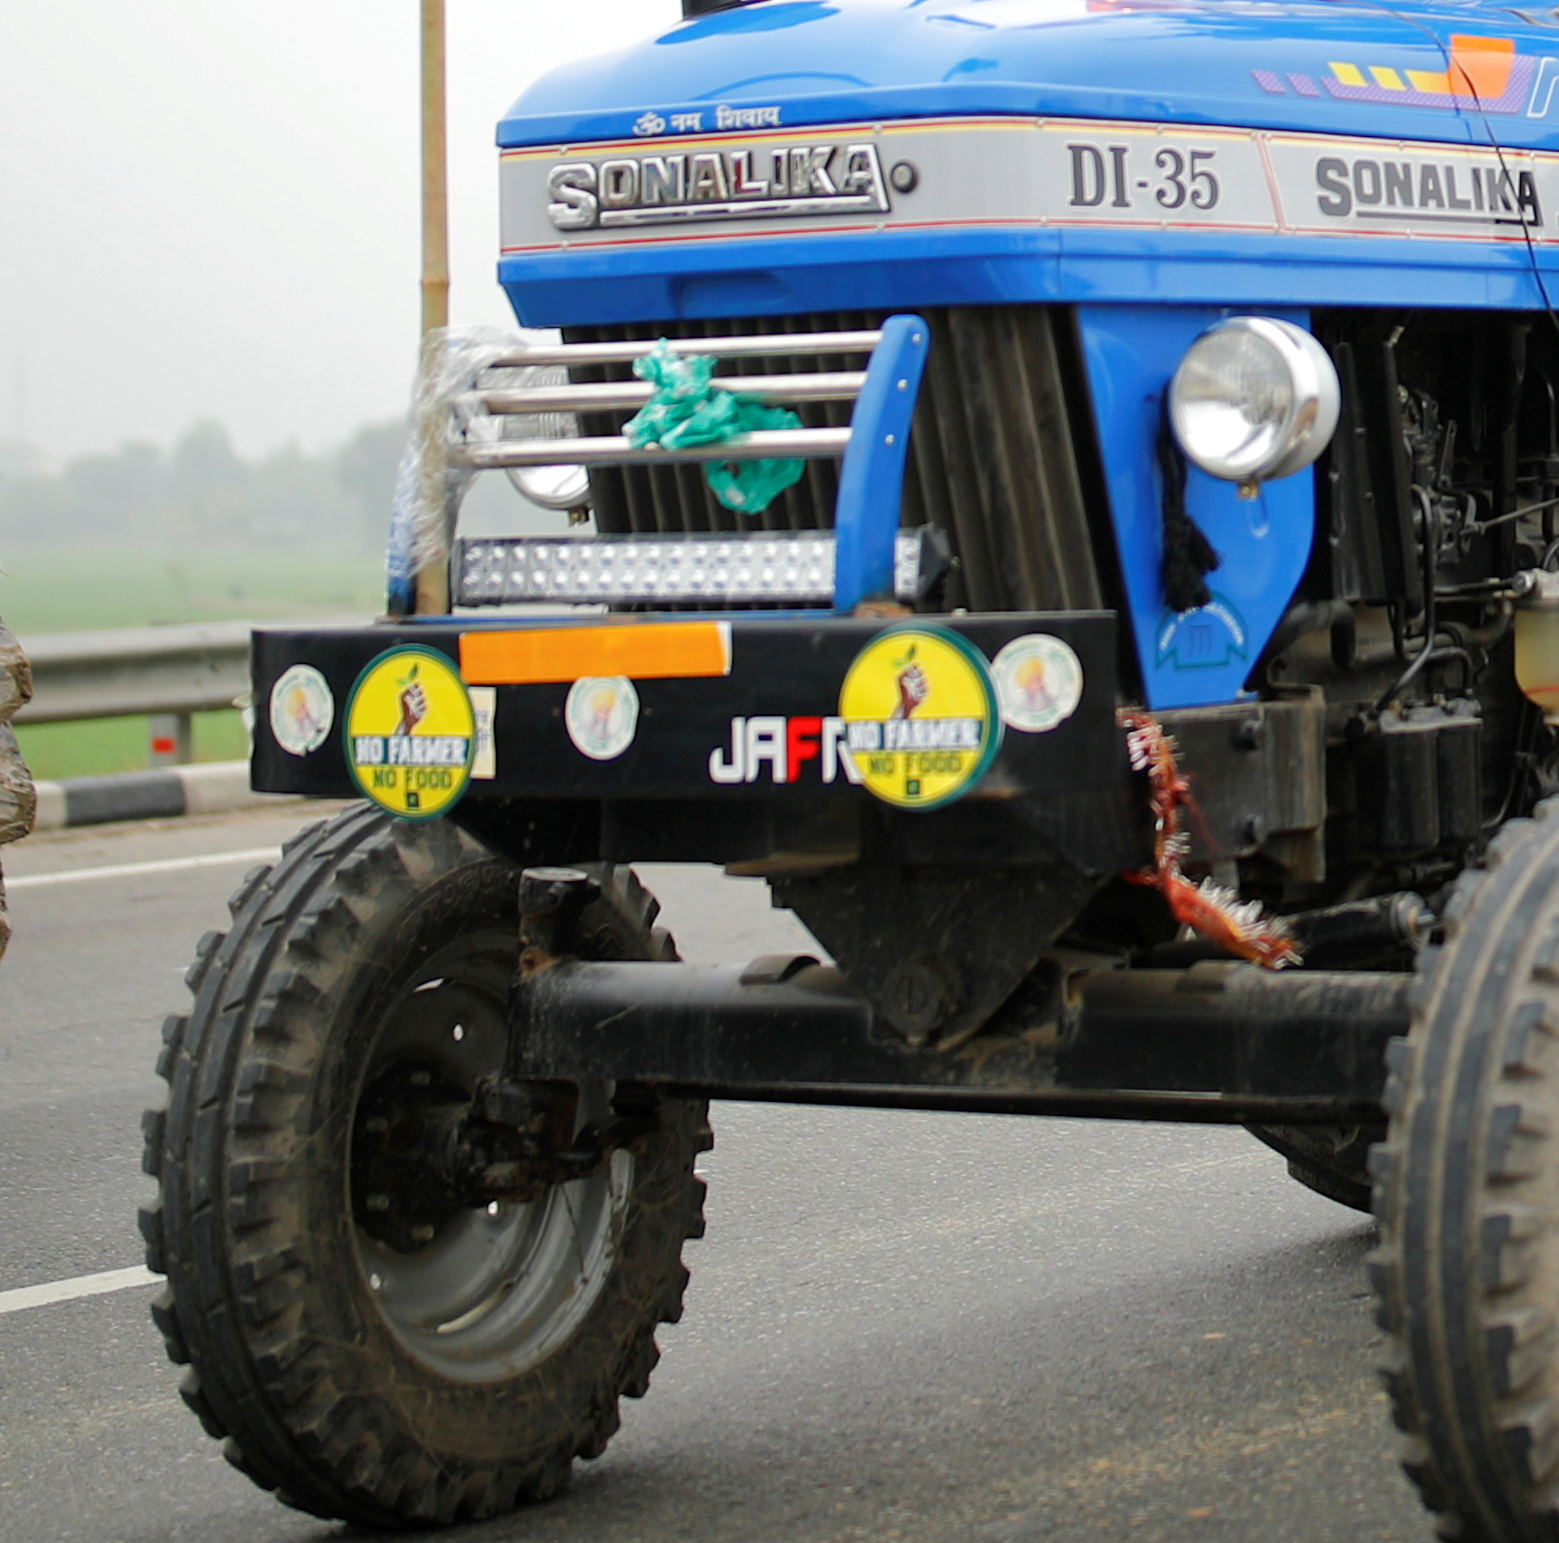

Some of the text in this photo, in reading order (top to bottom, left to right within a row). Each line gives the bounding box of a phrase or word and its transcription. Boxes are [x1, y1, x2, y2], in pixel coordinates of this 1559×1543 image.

[715, 105, 782, 130] शिवाय
[548, 143, 892, 230] SONALIKA
[1067, 144, 1220, 210] DI-35
[1316, 156, 1544, 227] SONALIKA
[847, 717, 983, 750] NO FARMER
[355, 737, 467, 765] NO FARMER
[868, 753, 962, 774] NO FOOD
[373, 768, 452, 788] NO FOOD
